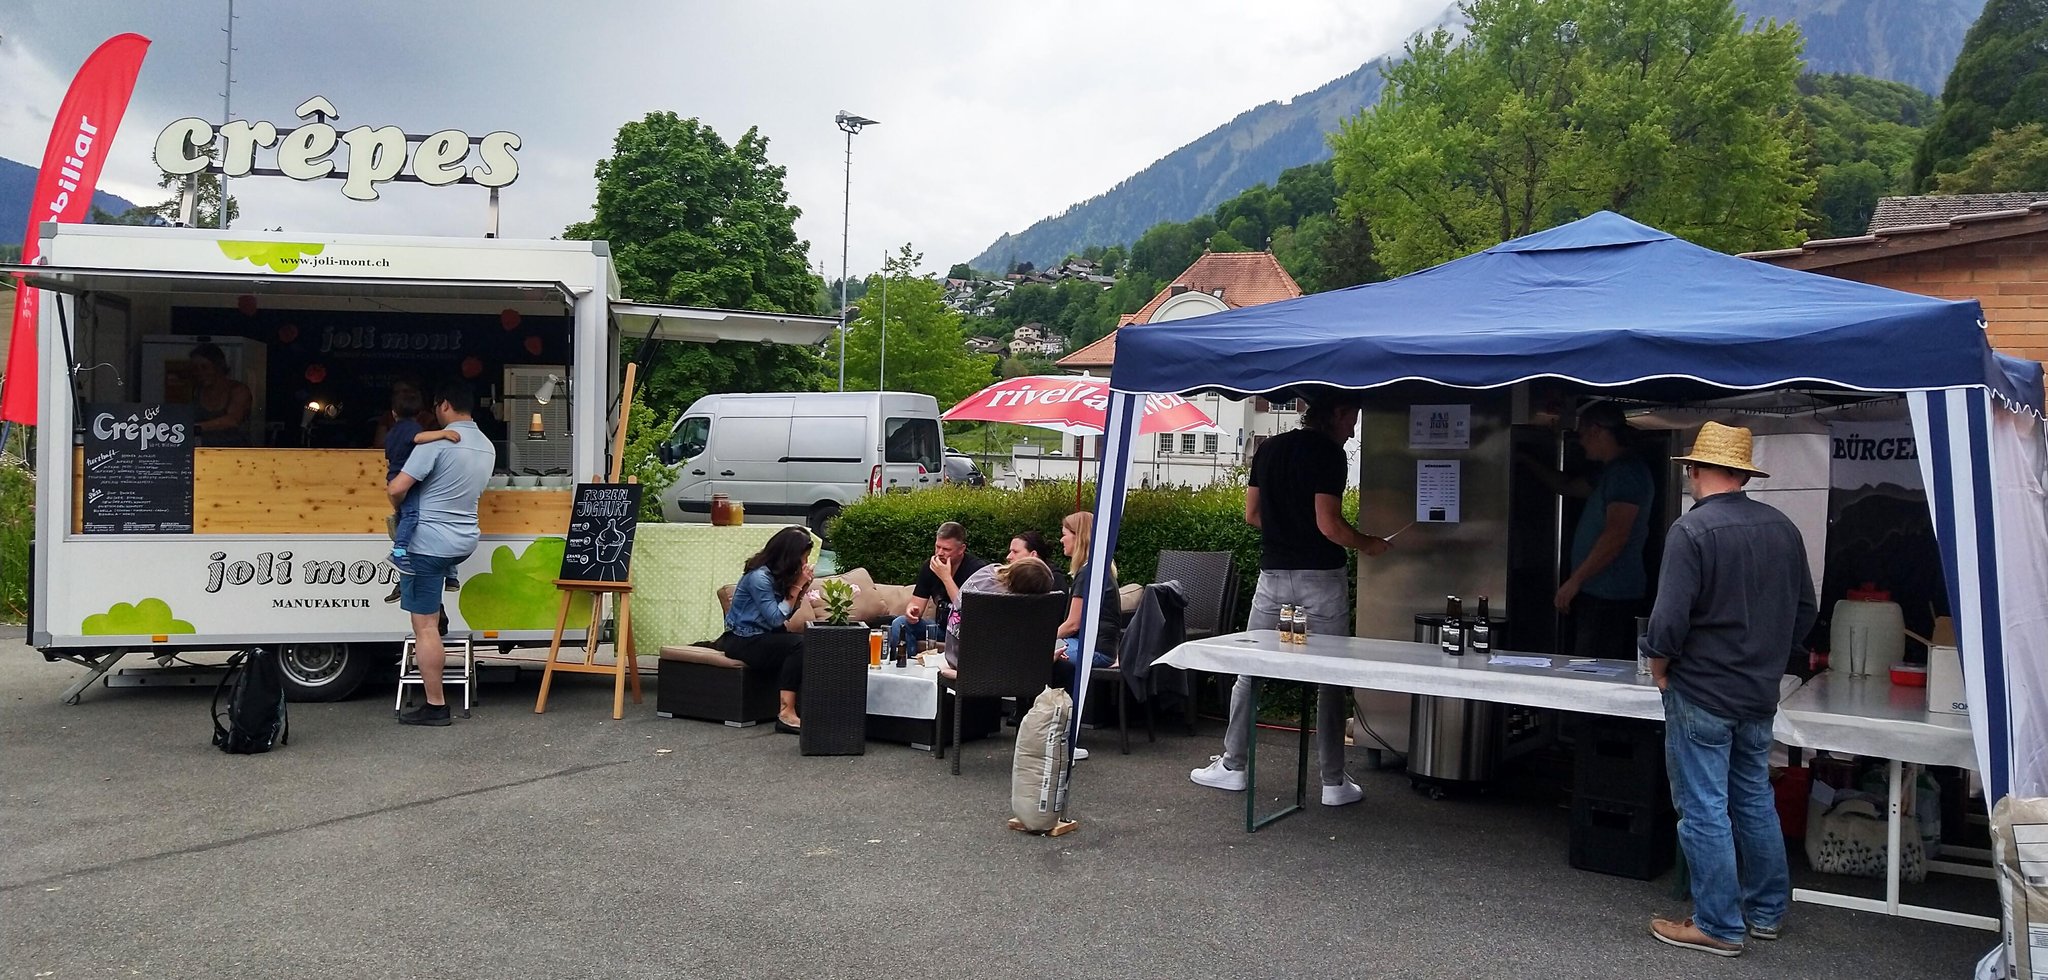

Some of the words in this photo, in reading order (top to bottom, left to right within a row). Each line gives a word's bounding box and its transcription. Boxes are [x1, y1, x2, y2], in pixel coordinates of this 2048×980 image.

[154, 95, 522, 200] crêpes
[38, 115, 97, 240] biliar
[280, 256, 390, 268] www.joli-mont.ch
[320, 326, 376, 352] joli
[985, 383, 1108, 411] rivella
[93, 412, 186, 451] Crêpes
[86, 449, 120, 466] herzhaft
[583, 489, 629, 500] FROZEN
[577, 501, 632, 517] JOGHURT
[205, 551, 293, 593] joli
[303, 560, 401, 585] mon
[271, 598, 371, 608] MANUFAKTUR
